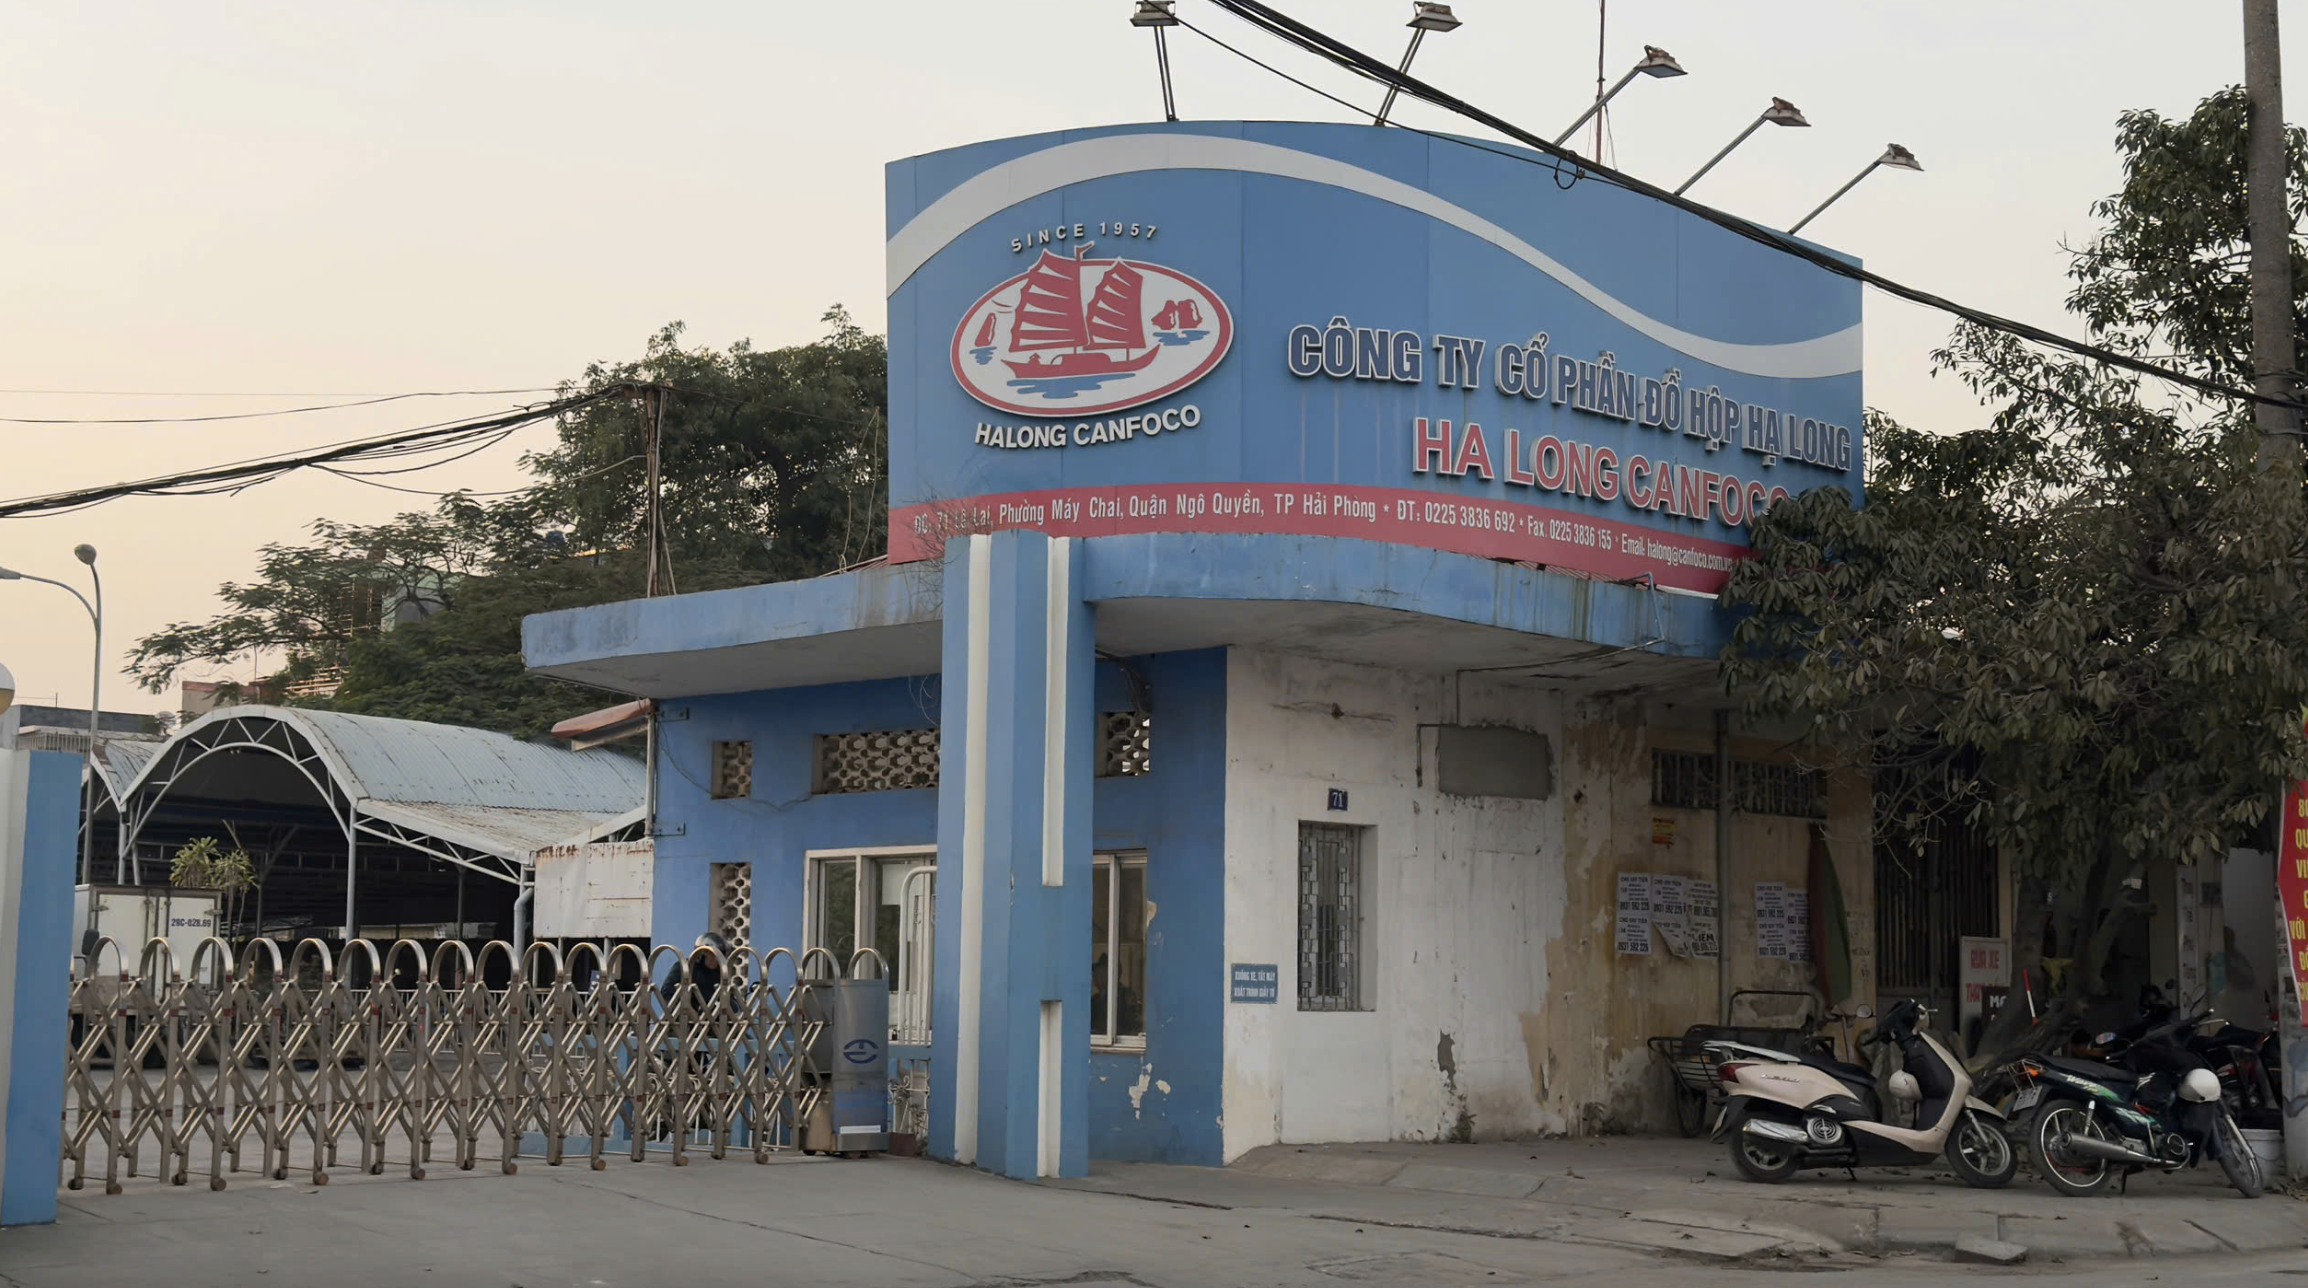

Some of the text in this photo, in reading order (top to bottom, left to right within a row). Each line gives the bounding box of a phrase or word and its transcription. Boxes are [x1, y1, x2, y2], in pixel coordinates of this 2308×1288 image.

[1011, 222, 1157, 252] SINCE 1957
[1288, 315, 1851, 471] CÔNG TY CỔ PHẦN ĐỒ HỘP HẠ LONG
[974, 404, 1201, 449] HALONG CANFOCO
[1413, 417, 1494, 479] HA
[1504, 428, 1619, 501] LONG
[999, 499, 1044, 526] Phường
[1052, 497, 1080, 523] Máy
[1089, 496, 1124, 519] Chai,
[1129, 494, 1167, 519] Quận
[1176, 493, 1205, 518] Ngô
[1213, 489, 1264, 518] Quyền,
[1274, 493, 1294, 514] TP
[1303, 492, 1327, 515] Hải
[1334, 495, 1376, 522] Phòng
[1397, 499, 1420, 521] ĐT:
[1425, 501, 1456, 525] 0225
[1460, 505, 1490, 529] 3836
[1494, 510, 1515, 533] 692
[1549, 519, 1571, 542] 0225
[1573, 523, 1595, 547] 3836
[1597, 529, 1611, 550] 155
[1331, 792, 1343, 808] 71
